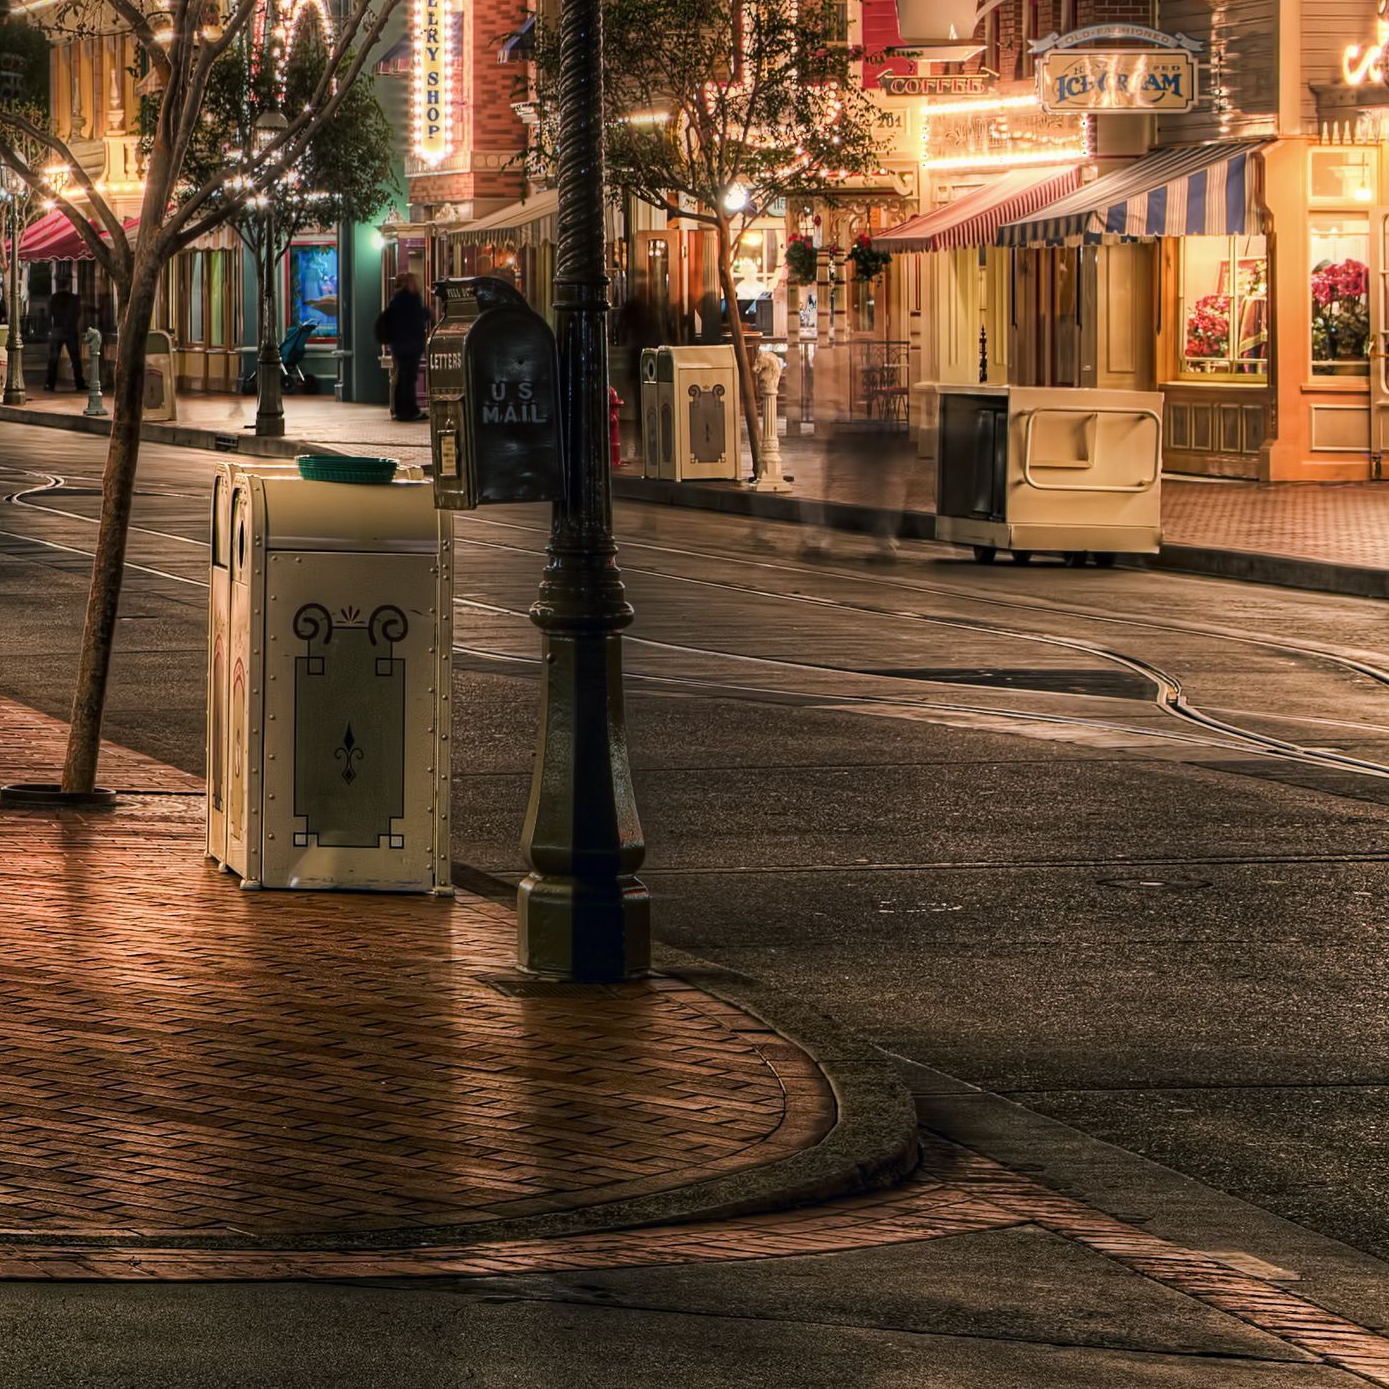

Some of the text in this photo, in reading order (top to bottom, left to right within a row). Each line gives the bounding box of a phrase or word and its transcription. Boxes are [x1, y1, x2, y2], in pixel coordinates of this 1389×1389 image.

[890, 78, 986, 94] COFFEE
[1097, 70, 1183, 98] CRAM
[426, 71, 440, 139] SHOP
[430, 352, 462, 370] LETTERS
[491, 381, 533, 401] U S
[482, 403, 547, 424] MAIL
